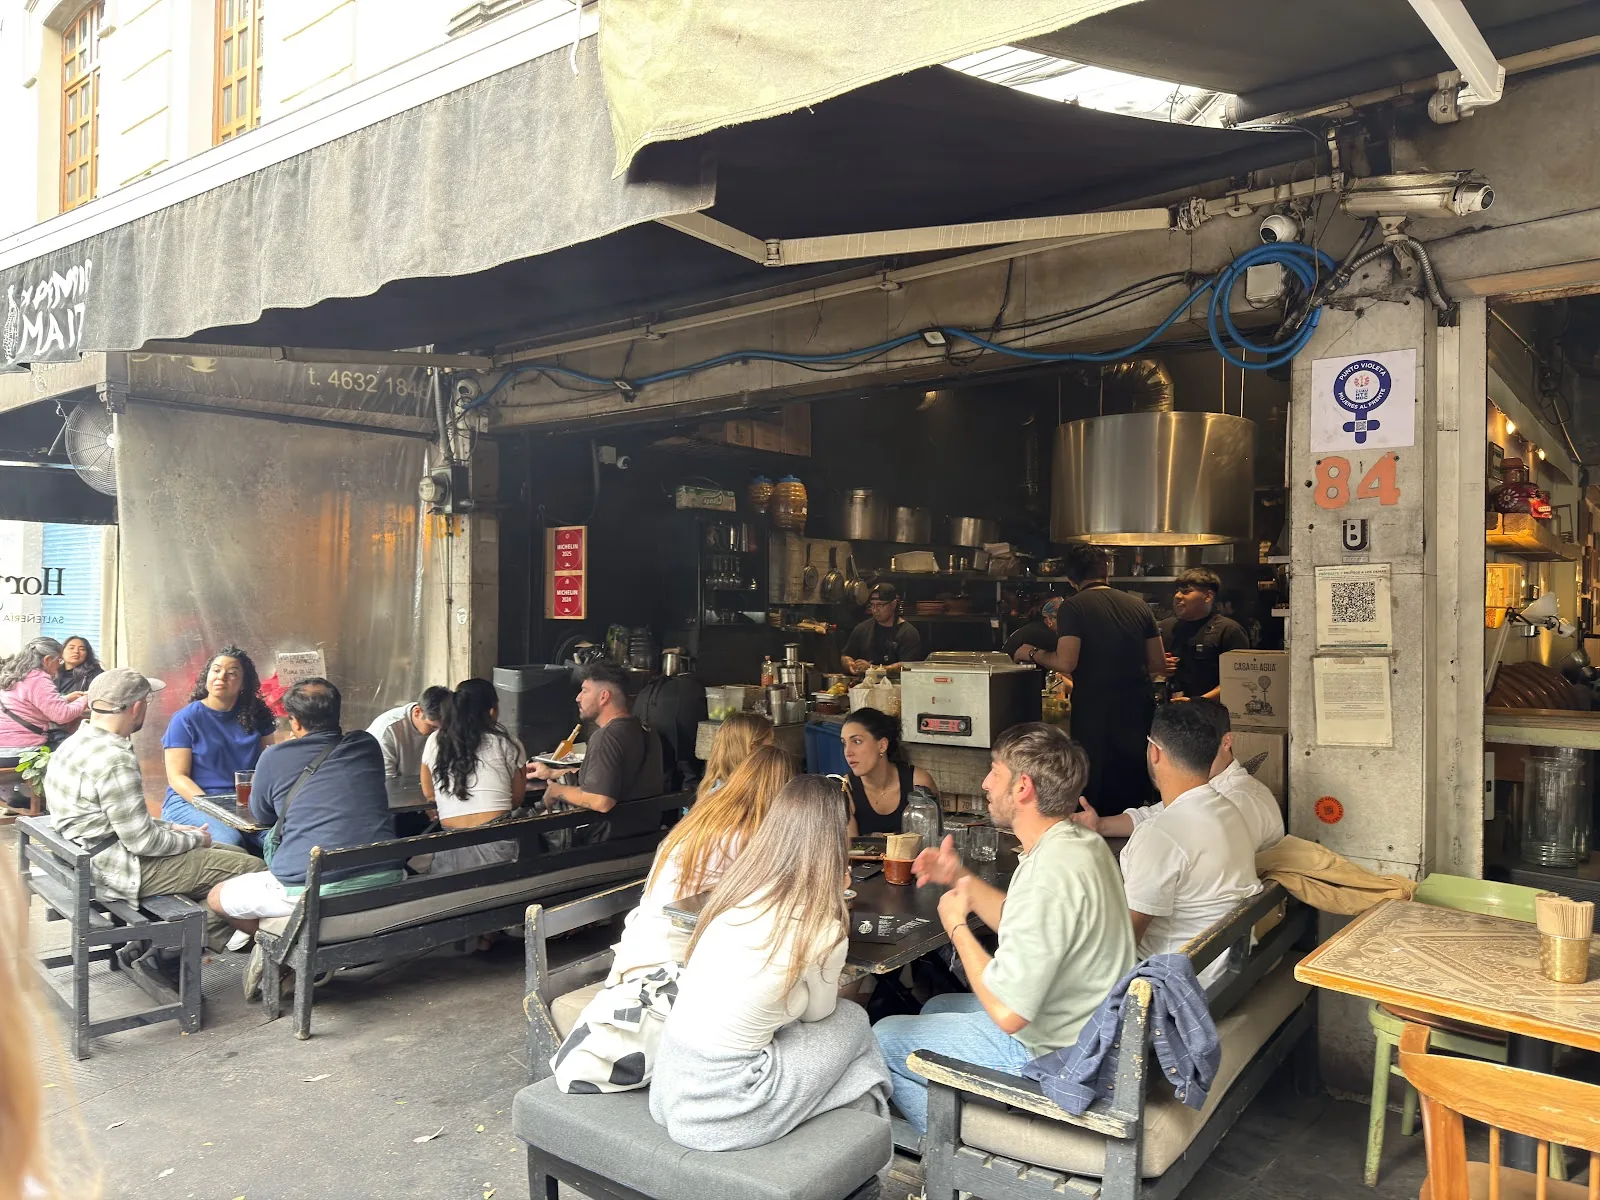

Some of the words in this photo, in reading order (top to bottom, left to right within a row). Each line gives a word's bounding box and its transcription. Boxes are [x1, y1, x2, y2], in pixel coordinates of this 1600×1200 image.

[328, 369, 378, 393] 4632
[1339, 364, 1359, 381] PUNTO
[1361, 363, 1387, 377] VIOLETA
[1338, 391, 1359, 410] MUJERES
[1368, 388, 1386, 407] FRENTE
[1313, 451, 1401, 510] 84
[1233, 662, 1251, 671] CASA
[1259, 663, 1277, 672] AGUA
